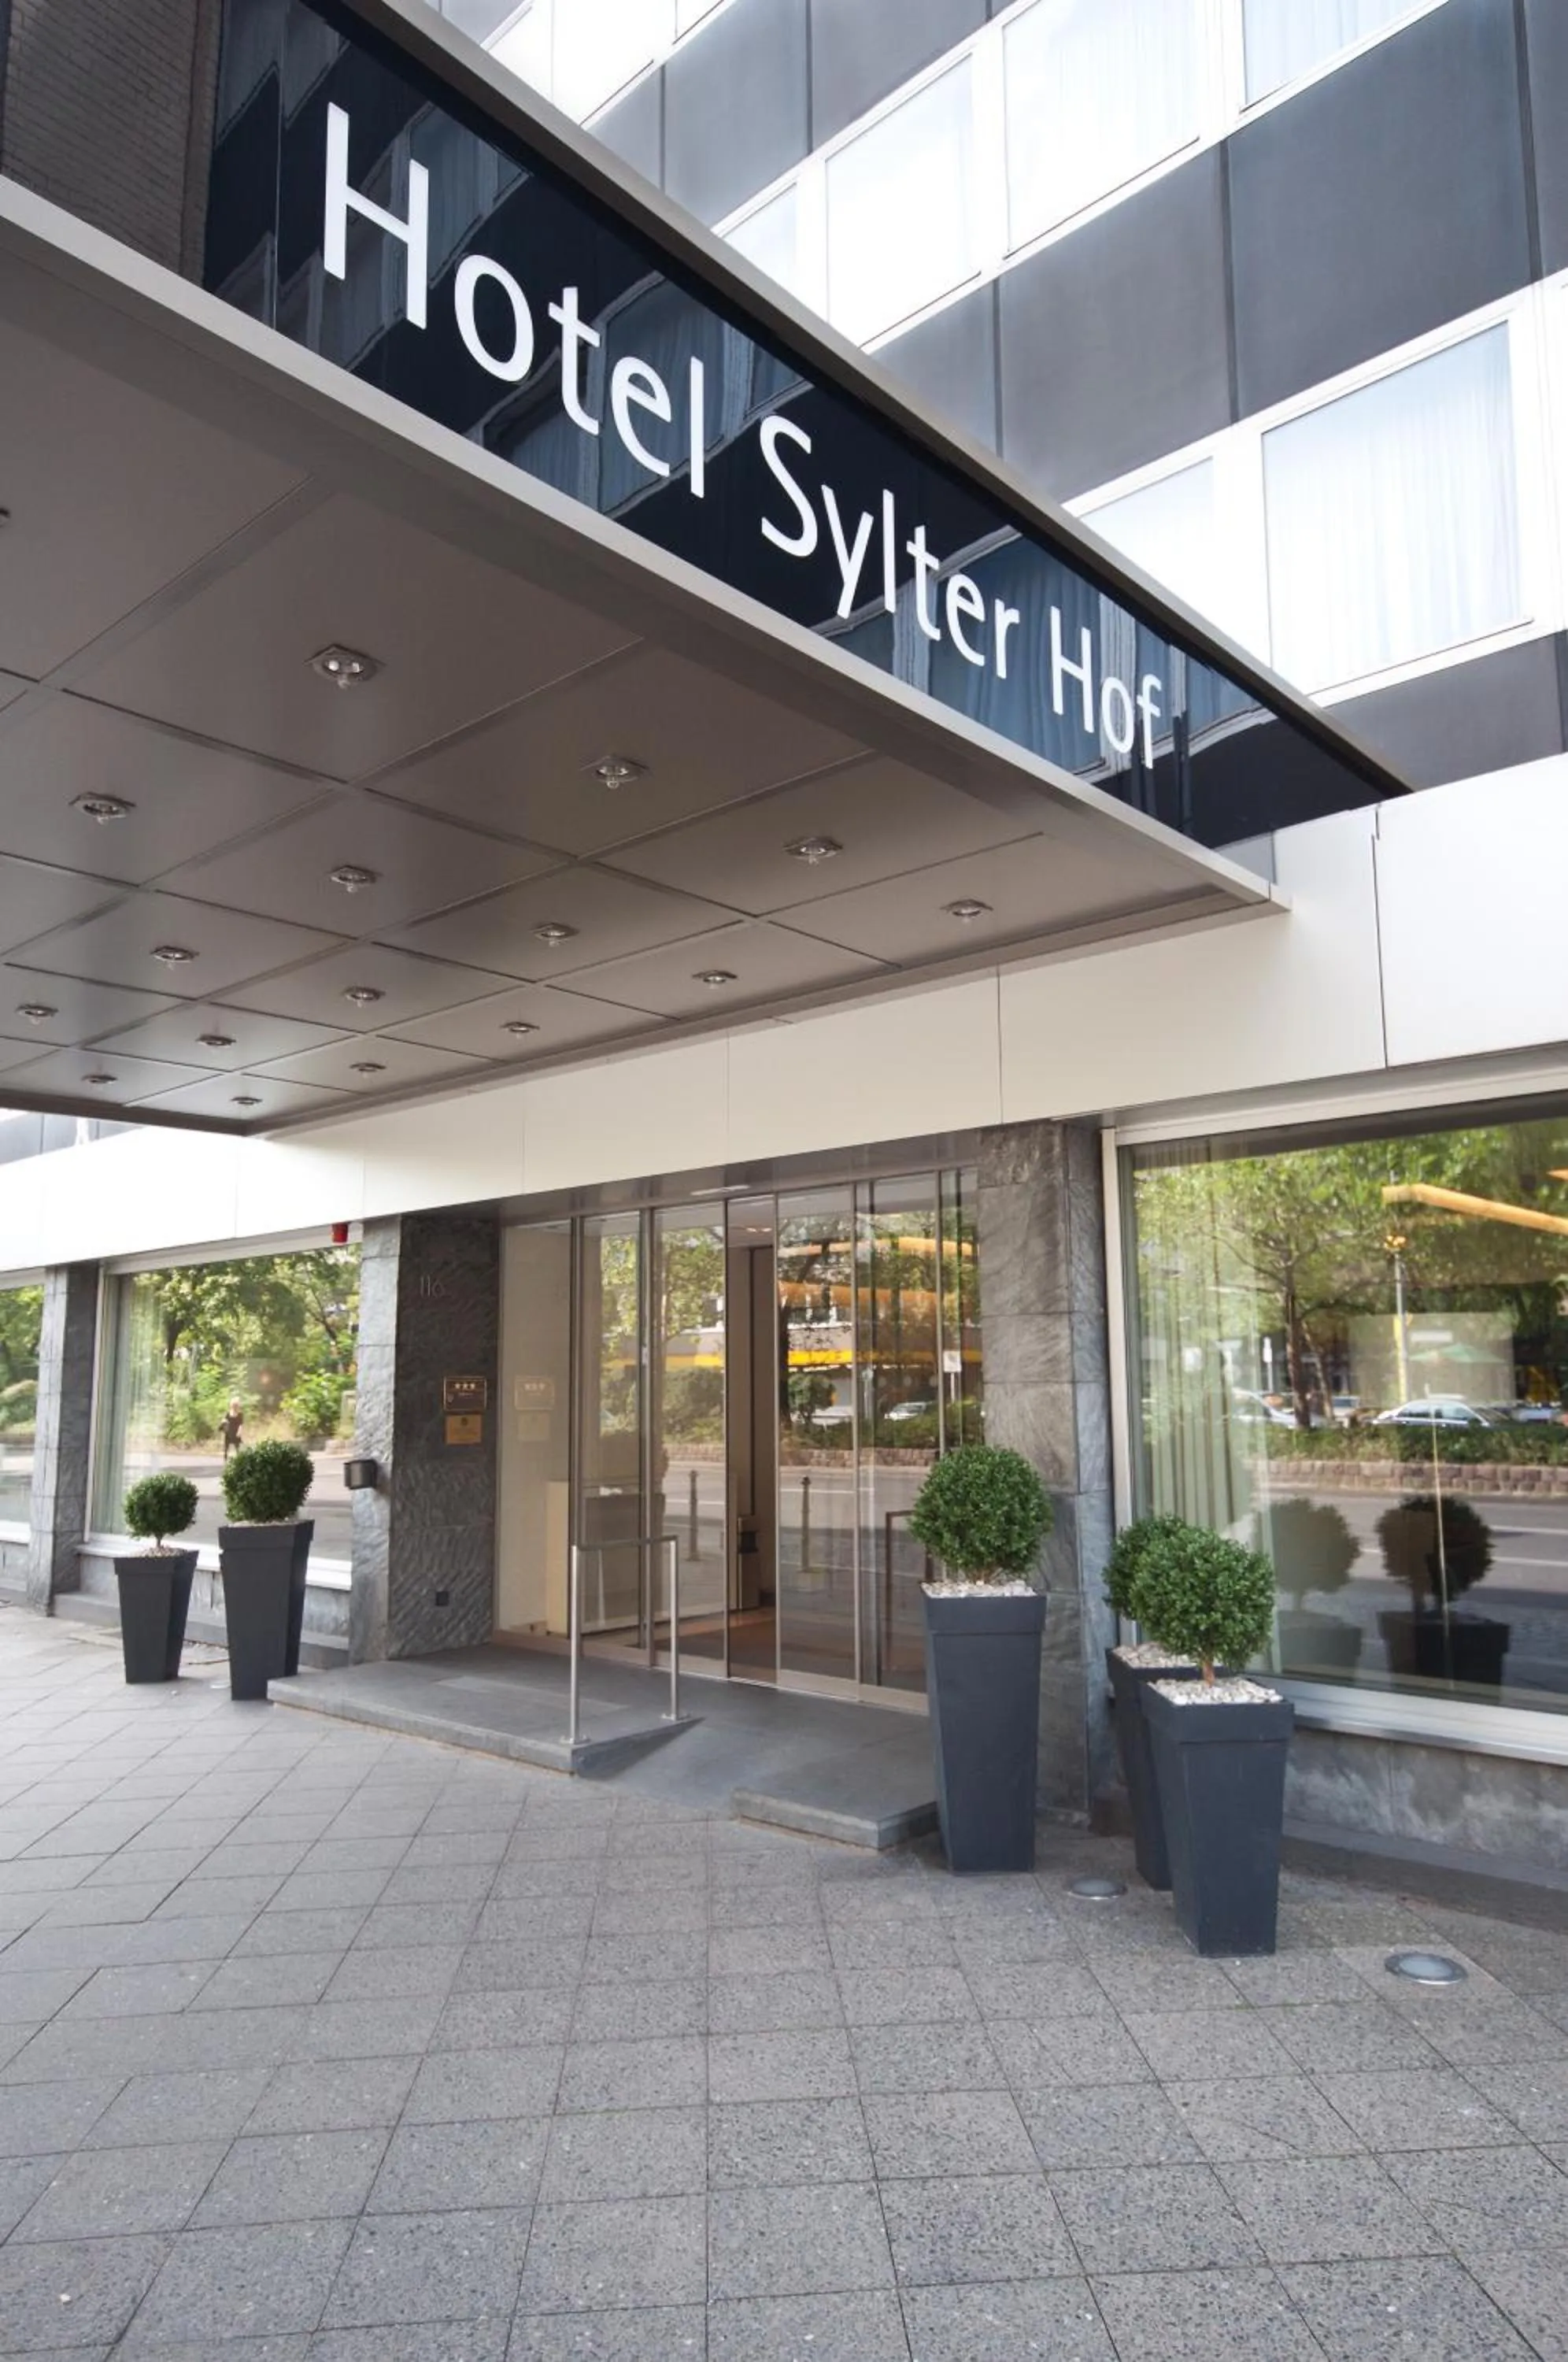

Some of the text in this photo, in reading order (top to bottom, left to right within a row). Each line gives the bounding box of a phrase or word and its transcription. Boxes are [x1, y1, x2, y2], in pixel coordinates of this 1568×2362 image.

[324, 102, 1162, 769] Hotel Sylter Hof
